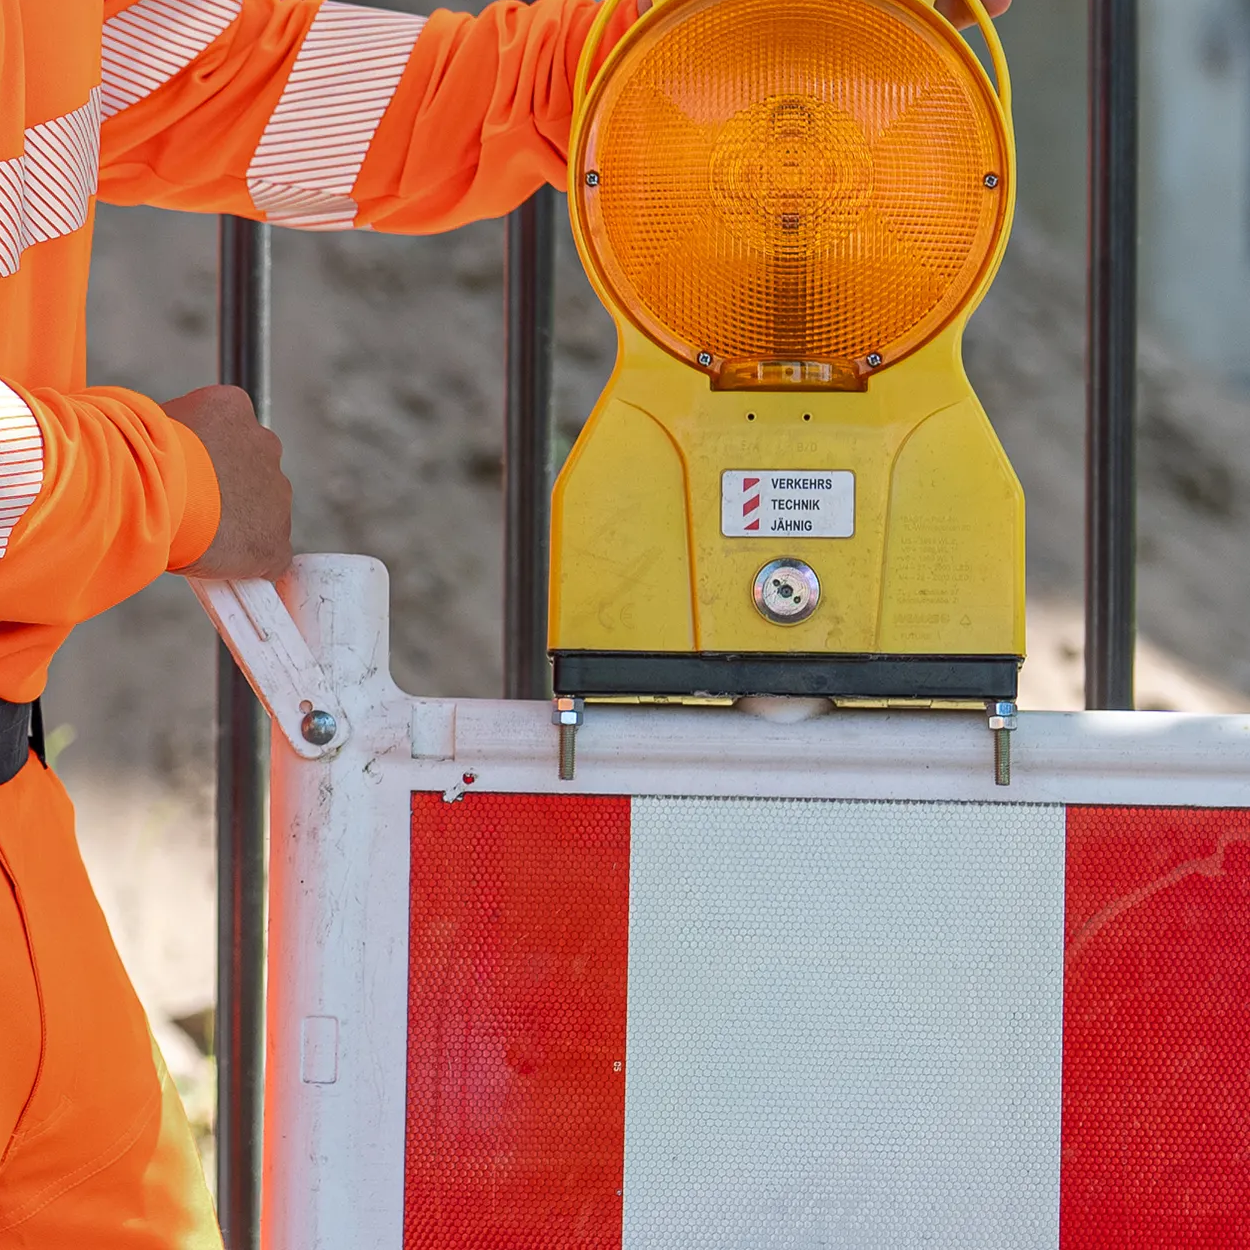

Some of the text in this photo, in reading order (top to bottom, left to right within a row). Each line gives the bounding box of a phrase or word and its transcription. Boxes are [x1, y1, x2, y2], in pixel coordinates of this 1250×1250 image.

[771, 478, 832, 490] VERKEHRS
[771, 499, 820, 511] TECHNIK
[770, 517, 813, 532] JÄHNIG
